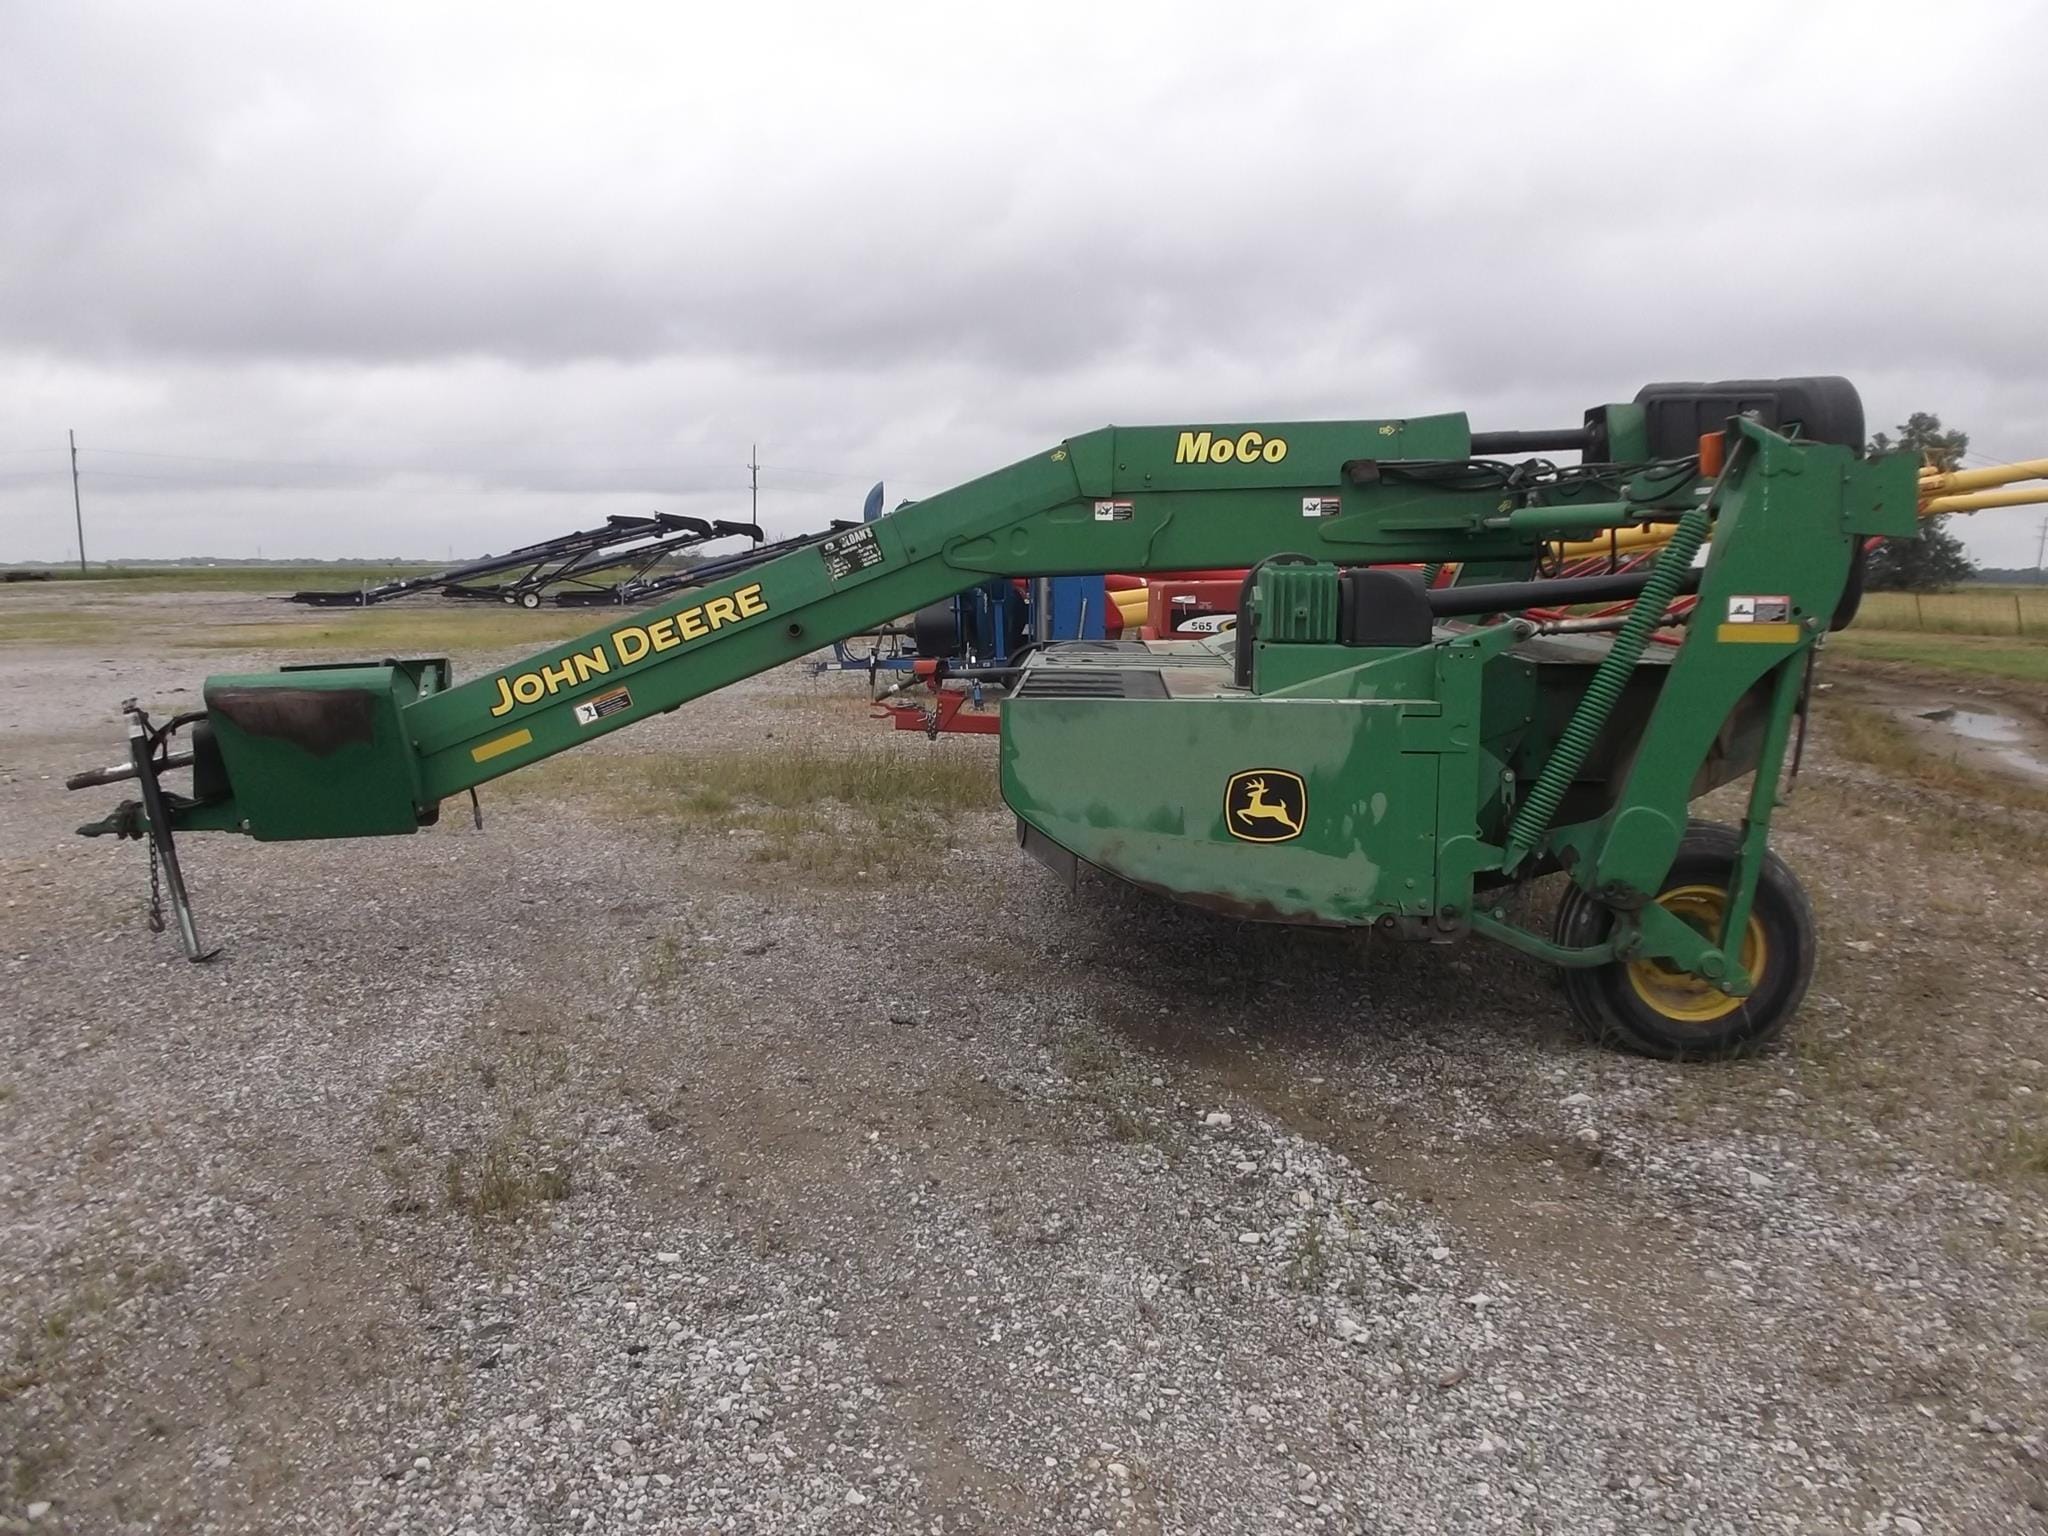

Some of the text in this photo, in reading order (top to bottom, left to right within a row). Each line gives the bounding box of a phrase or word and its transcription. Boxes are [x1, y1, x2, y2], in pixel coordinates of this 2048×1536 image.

[1175, 431, 1288, 464] MoCo
[1191, 621, 1213, 631] 565
[491, 583, 768, 717] JOHN DEERE
